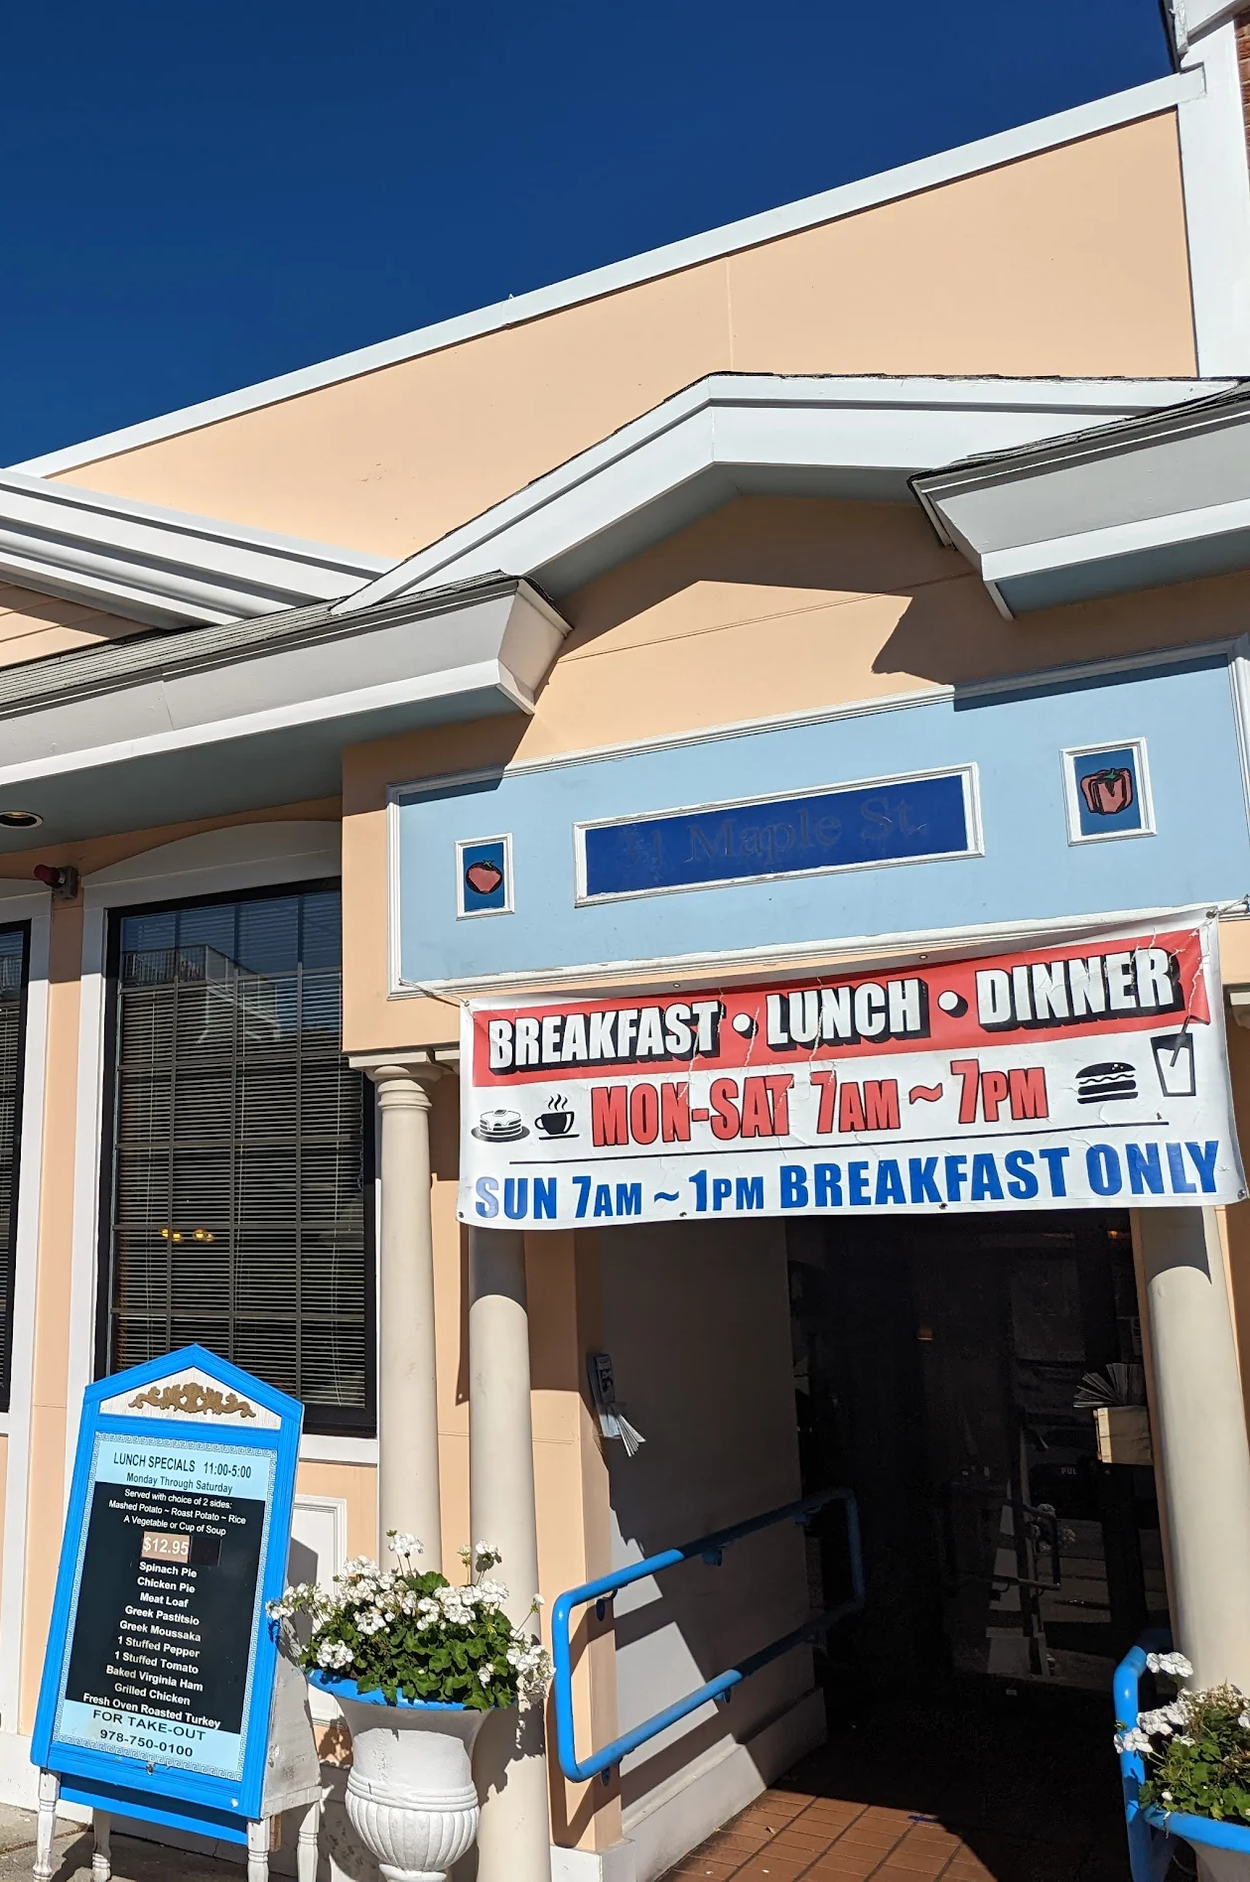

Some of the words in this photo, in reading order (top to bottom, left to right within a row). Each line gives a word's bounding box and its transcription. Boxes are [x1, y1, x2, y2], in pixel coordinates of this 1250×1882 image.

[685, 808, 842, 864] Maple
[860, 796, 927, 841] St.
[488, 1001, 721, 1073] BREAKFAST
[767, 979, 927, 1050] LUNCH
[975, 947, 1179, 1028] DINNER
[591, 1074, 794, 1147] MON-SAT
[810, 1070, 901, 1134] 7AM
[950, 1059, 1049, 1124] 7PM
[475, 1175, 557, 1220] SUN
[572, 1175, 642, 1218] 7AM
[688, 1169, 764, 1212] 1PM
[780, 1147, 1071, 1211] BREAKFAST
[1076, 1140, 1220, 1198] ONLY
[114, 1452, 146, 1467] LUNCH
[148, 1455, 196, 1473] SPECIALS
[204, 1462, 252, 1479] 11:00-5:00
[1061, 1467, 1078, 1475] PUL
[127, 1472, 158, 1486] Monday
[160, 1476, 194, 1491] Through
[196, 1480, 233, 1495] Saturday
[125, 1488, 150, 1500] Served
[151, 1491, 167, 1501] with
[167, 1493, 193, 1505] choice
[193, 1496, 202, 1506] of
[203, 1498, 209, 1507] 2
[209, 1499, 232, 1509] sides:
[108, 1499, 138, 1512] Mashed
[139, 1503, 163, 1515] Potato
[171, 1507, 194, 1519] Roast
[194, 1510, 220, 1522] Potato
[228, 1514, 247, 1525] Rice
[123, 1514, 130, 1523] A
[132, 1515, 168, 1529] Vegetable
[169, 1521, 178, 1529] or
[179, 1521, 195, 1533] Cup
[196, 1524, 205, 1533] of
[205, 1525, 227, 1537] Soup
[143, 1536, 189, 1555] $12.95
[139, 1561, 179, 1576] Spinach
[181, 1567, 198, 1578] Pie
[137, 1577, 177, 1591] Chicken
[179, 1583, 196, 1593] Pie
[140, 1592, 164, 1604] Meat
[166, 1596, 189, 1608] Loaf
[125, 1605, 154, 1618] Greek
[156, 1610, 200, 1626] Pastitsio
[120, 1620, 148, 1633] Greek
[150, 1625, 201, 1642] Moussaka
[125, 1637, 161, 1651] Stuffed
[163, 1643, 200, 1658] Pepper
[123, 1652, 158, 1666] Stuffed
[161, 1660, 199, 1674] Tomato
[106, 1665, 137, 1679] Baked
[139, 1671, 177, 1687] Virginia
[179, 1679, 204, 1692] Ham
[114, 1682, 147, 1697] Grilled
[149, 1689, 191, 1706] Chicken
[83, 1692, 111, 1707] Fresh
[112, 1698, 138, 1712] Oven
[140, 1703, 182, 1721] Roasted
[185, 1713, 221, 1730] Turkey
[93, 1709, 123, 1724] FOR
[128, 1716, 206, 1741] TAKE-OUT
[100, 1729, 193, 1757] 978-750-0100
